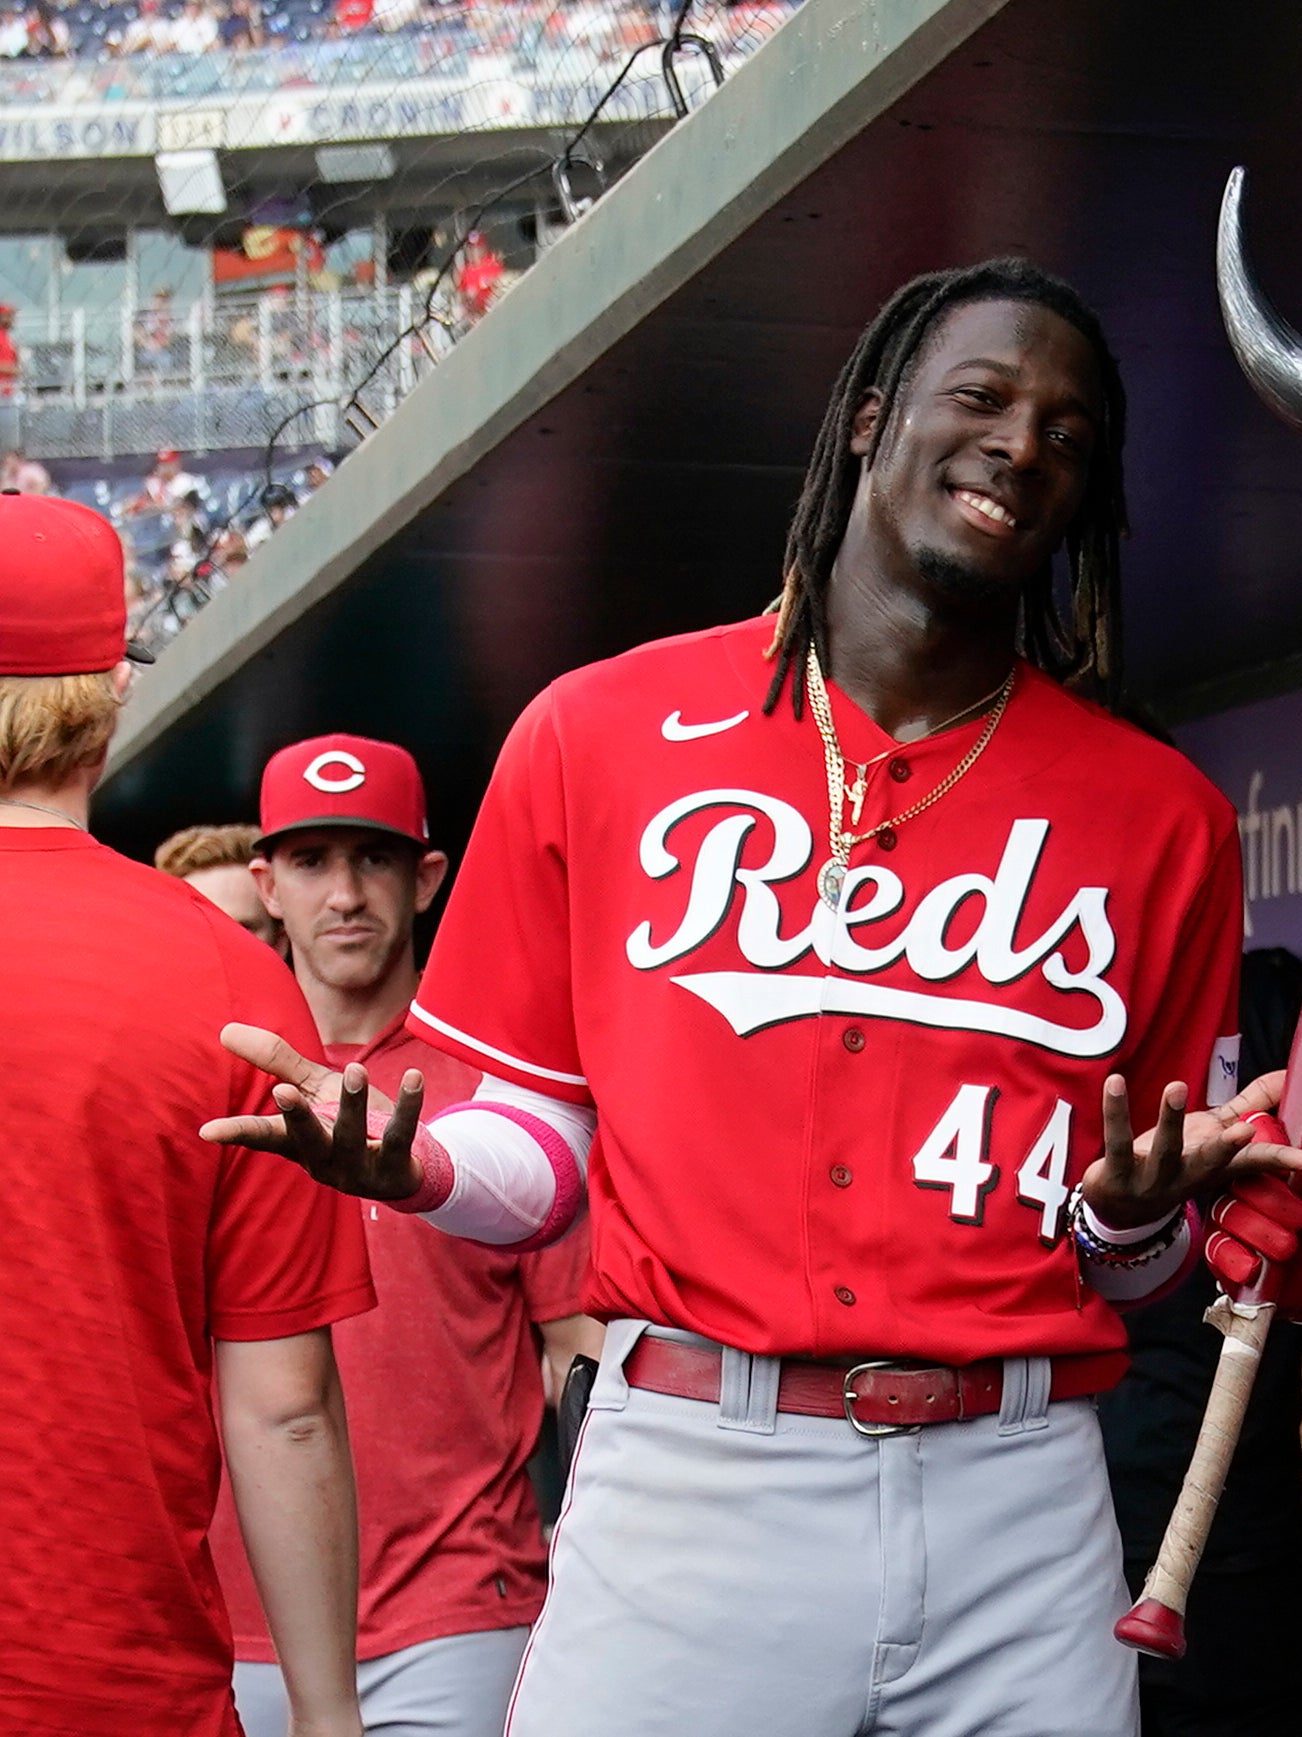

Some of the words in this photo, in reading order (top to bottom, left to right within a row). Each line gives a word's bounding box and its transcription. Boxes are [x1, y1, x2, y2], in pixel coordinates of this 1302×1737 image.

[0, 121, 140, 150] ILSON
[303, 750, 366, 794] C
[626, 788, 1128, 1060] Reds
[912, 1083, 1075, 1248] 44
